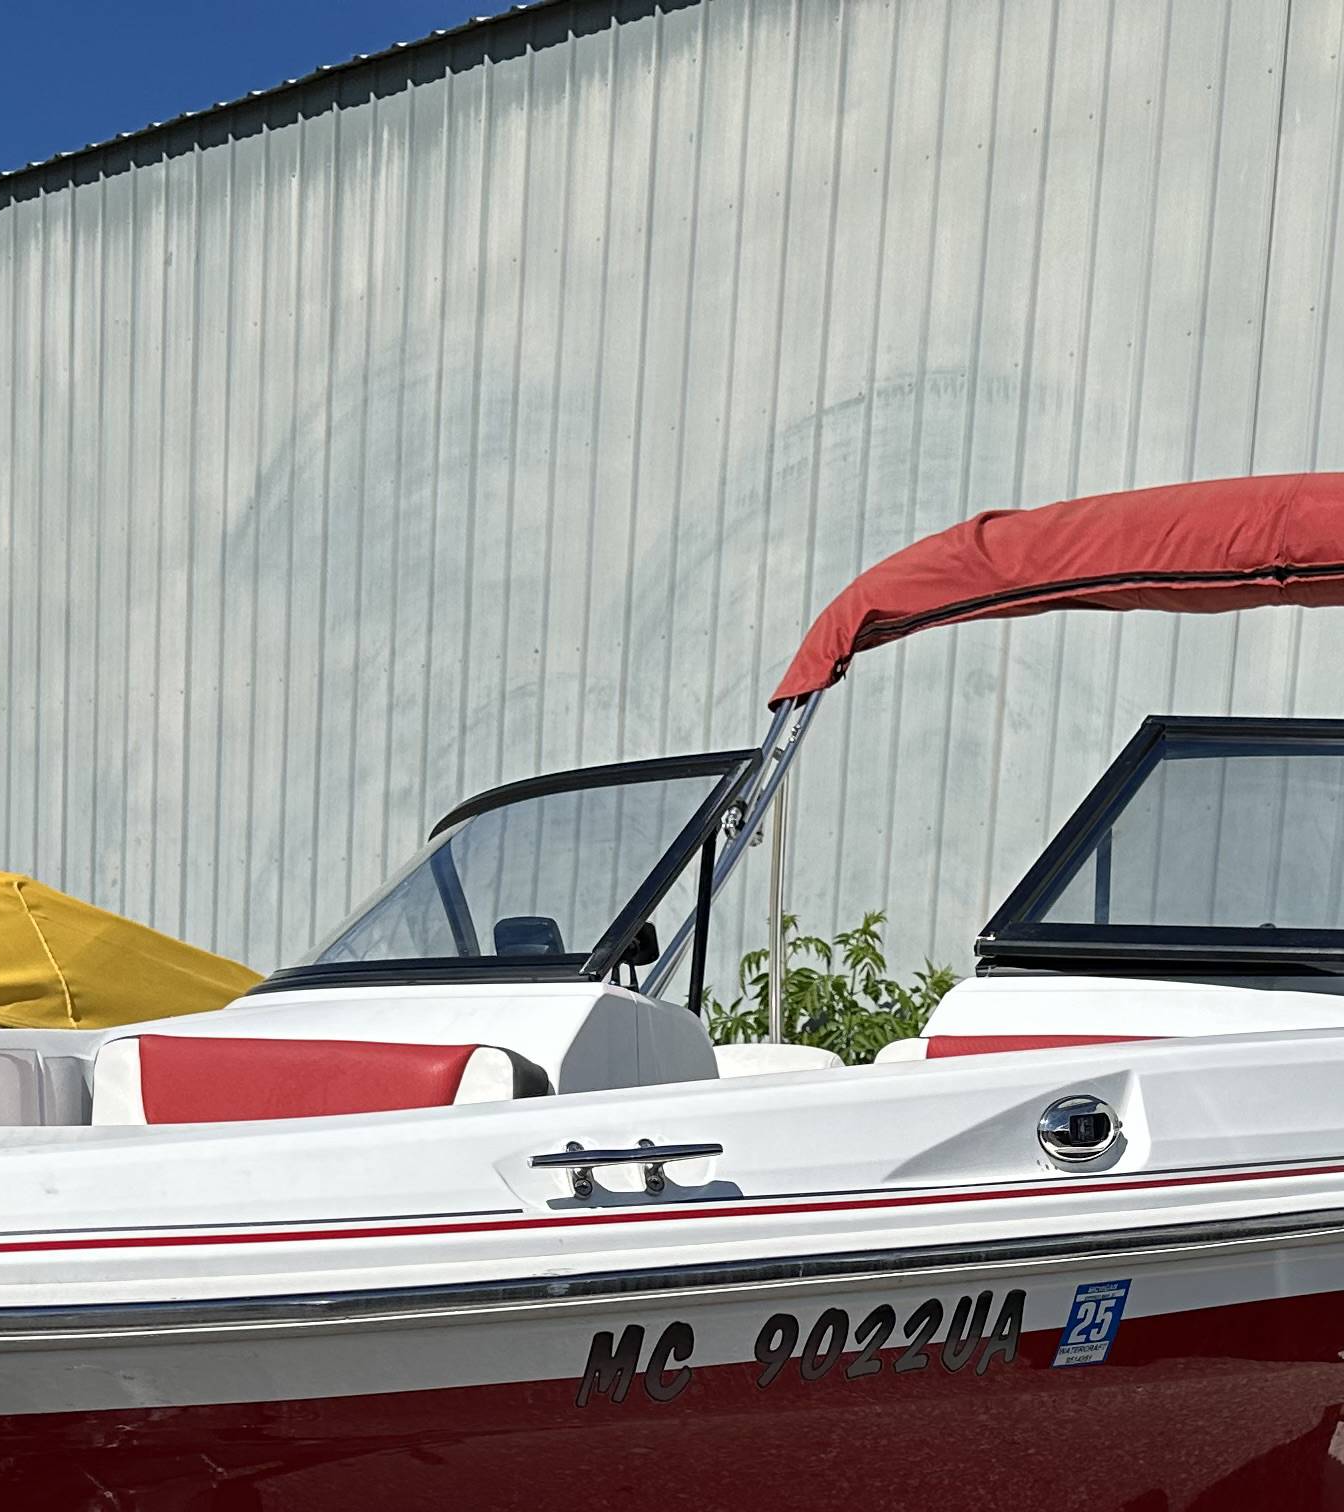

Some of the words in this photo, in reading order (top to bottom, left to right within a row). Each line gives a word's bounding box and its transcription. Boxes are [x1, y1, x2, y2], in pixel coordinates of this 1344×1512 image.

[576, 1321, 694, 1408] MC
[754, 1288, 1027, 1391] 9022UA
[1068, 1299, 1116, 1344] 25
